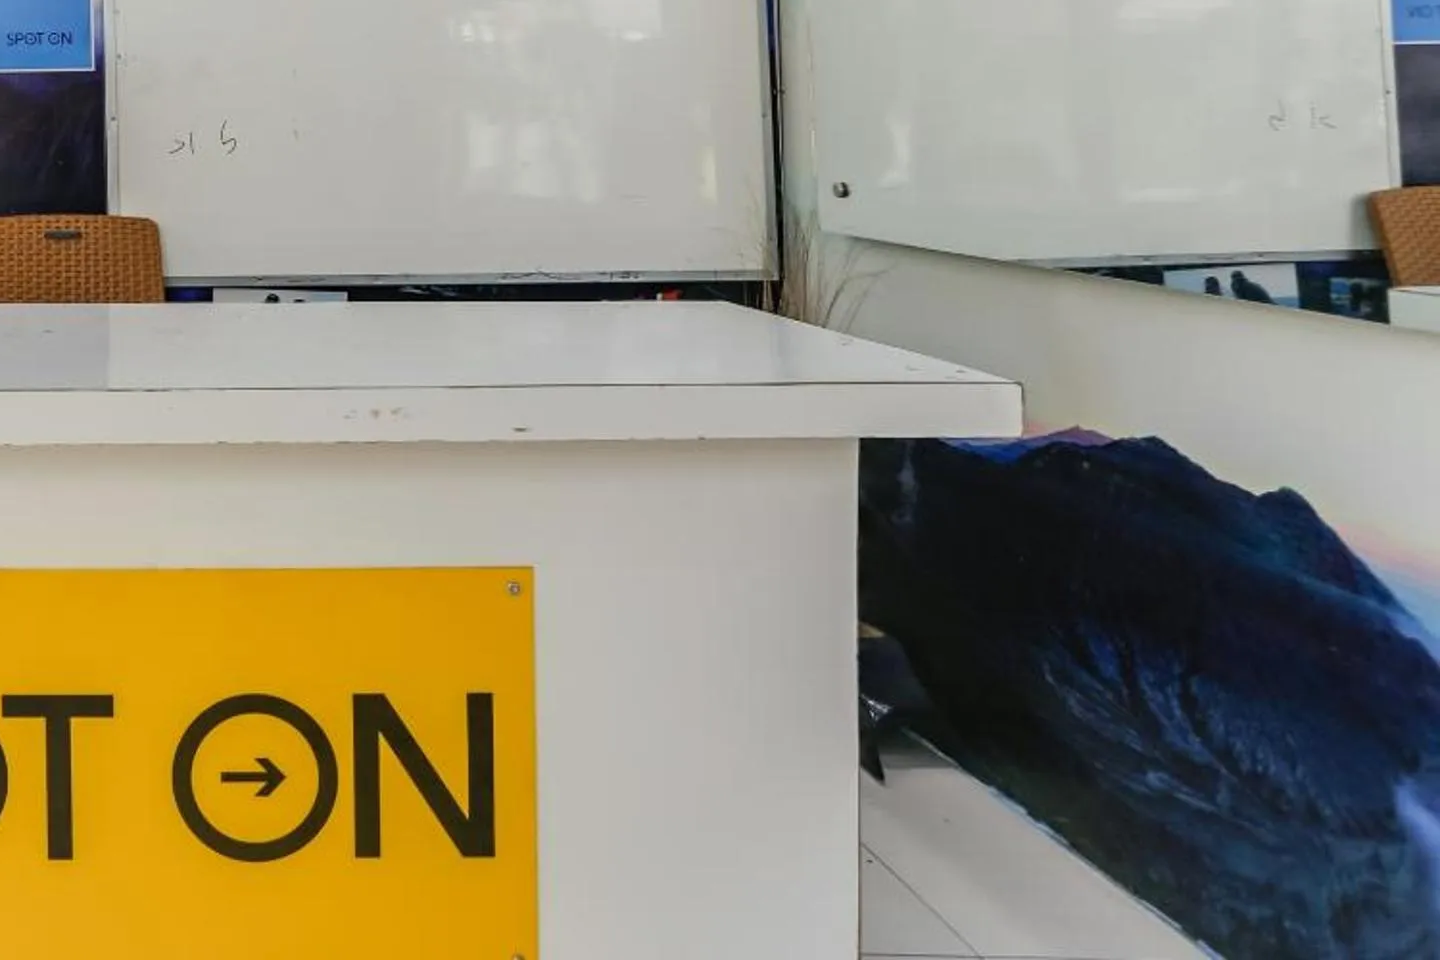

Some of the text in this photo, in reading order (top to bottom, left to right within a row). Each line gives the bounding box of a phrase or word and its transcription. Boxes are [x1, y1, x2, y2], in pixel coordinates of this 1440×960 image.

[6, 31, 73, 46] SPOT ON
[172, 692, 496, 863] ON
